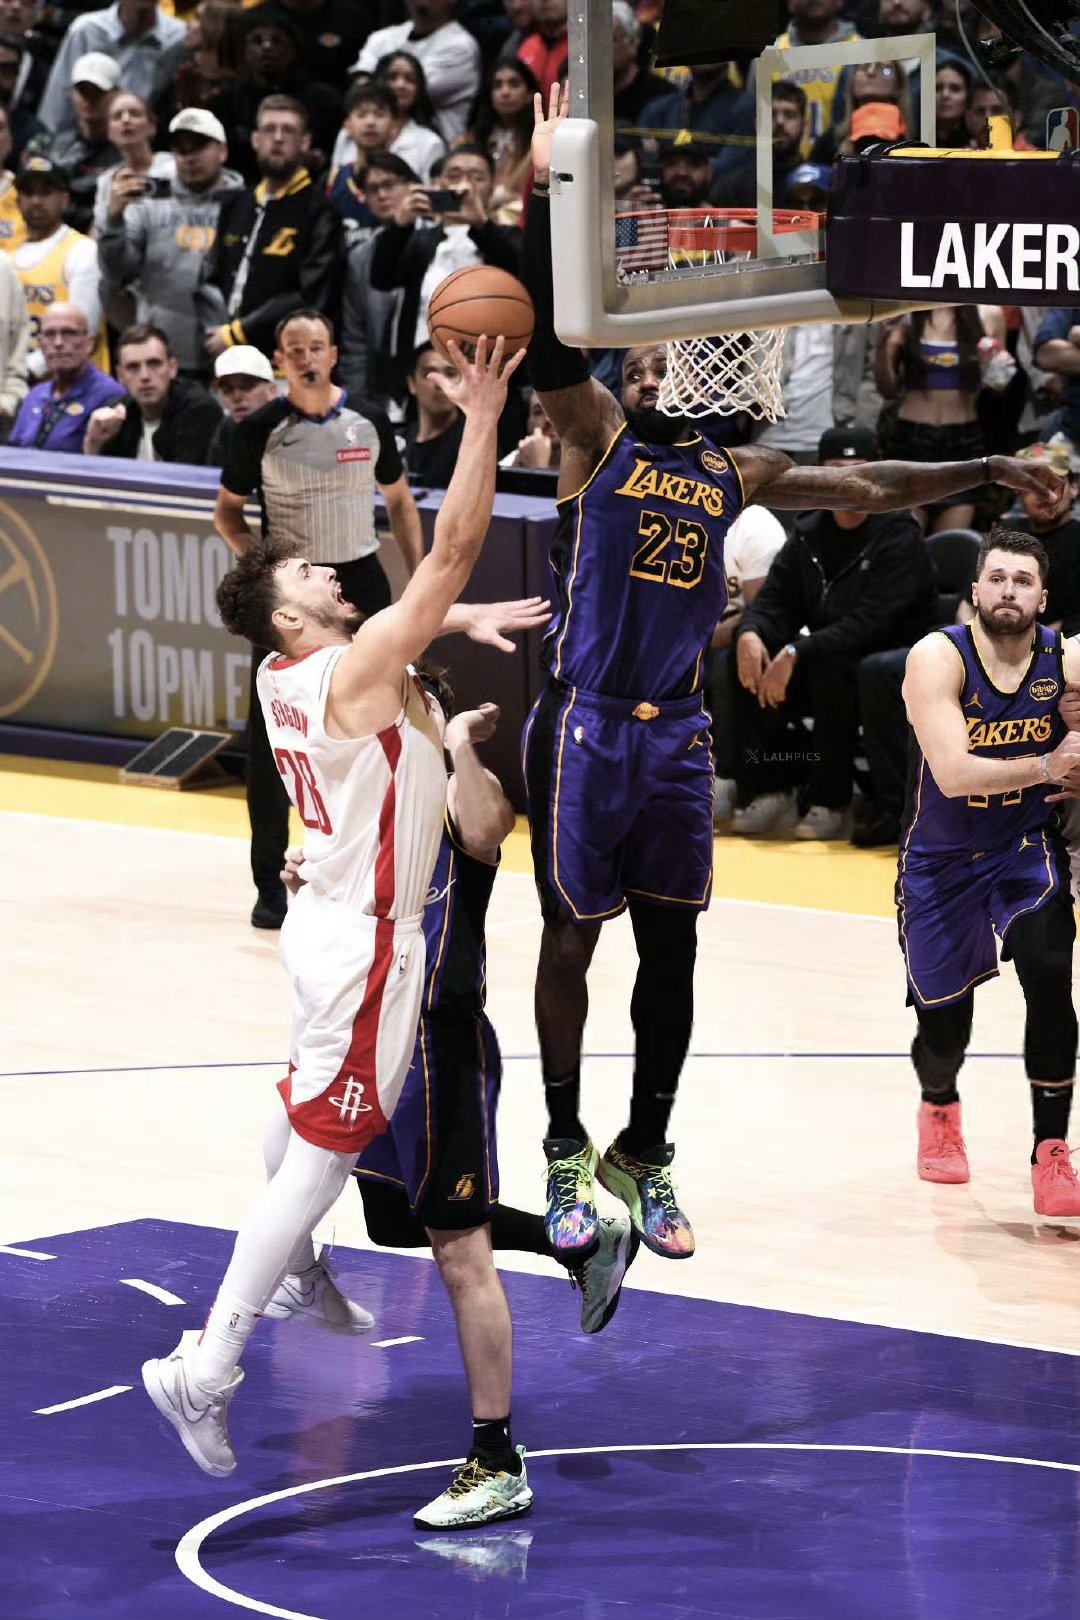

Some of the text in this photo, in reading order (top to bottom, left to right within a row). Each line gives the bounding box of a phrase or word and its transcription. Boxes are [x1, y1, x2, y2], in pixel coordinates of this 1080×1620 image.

[614, 458, 724, 517] LAKERS
[106, 526, 239, 628] TOMO
[629, 509, 708, 590] 23
[108, 627, 253, 731] 10PM E
[275, 748, 333, 836] 28
